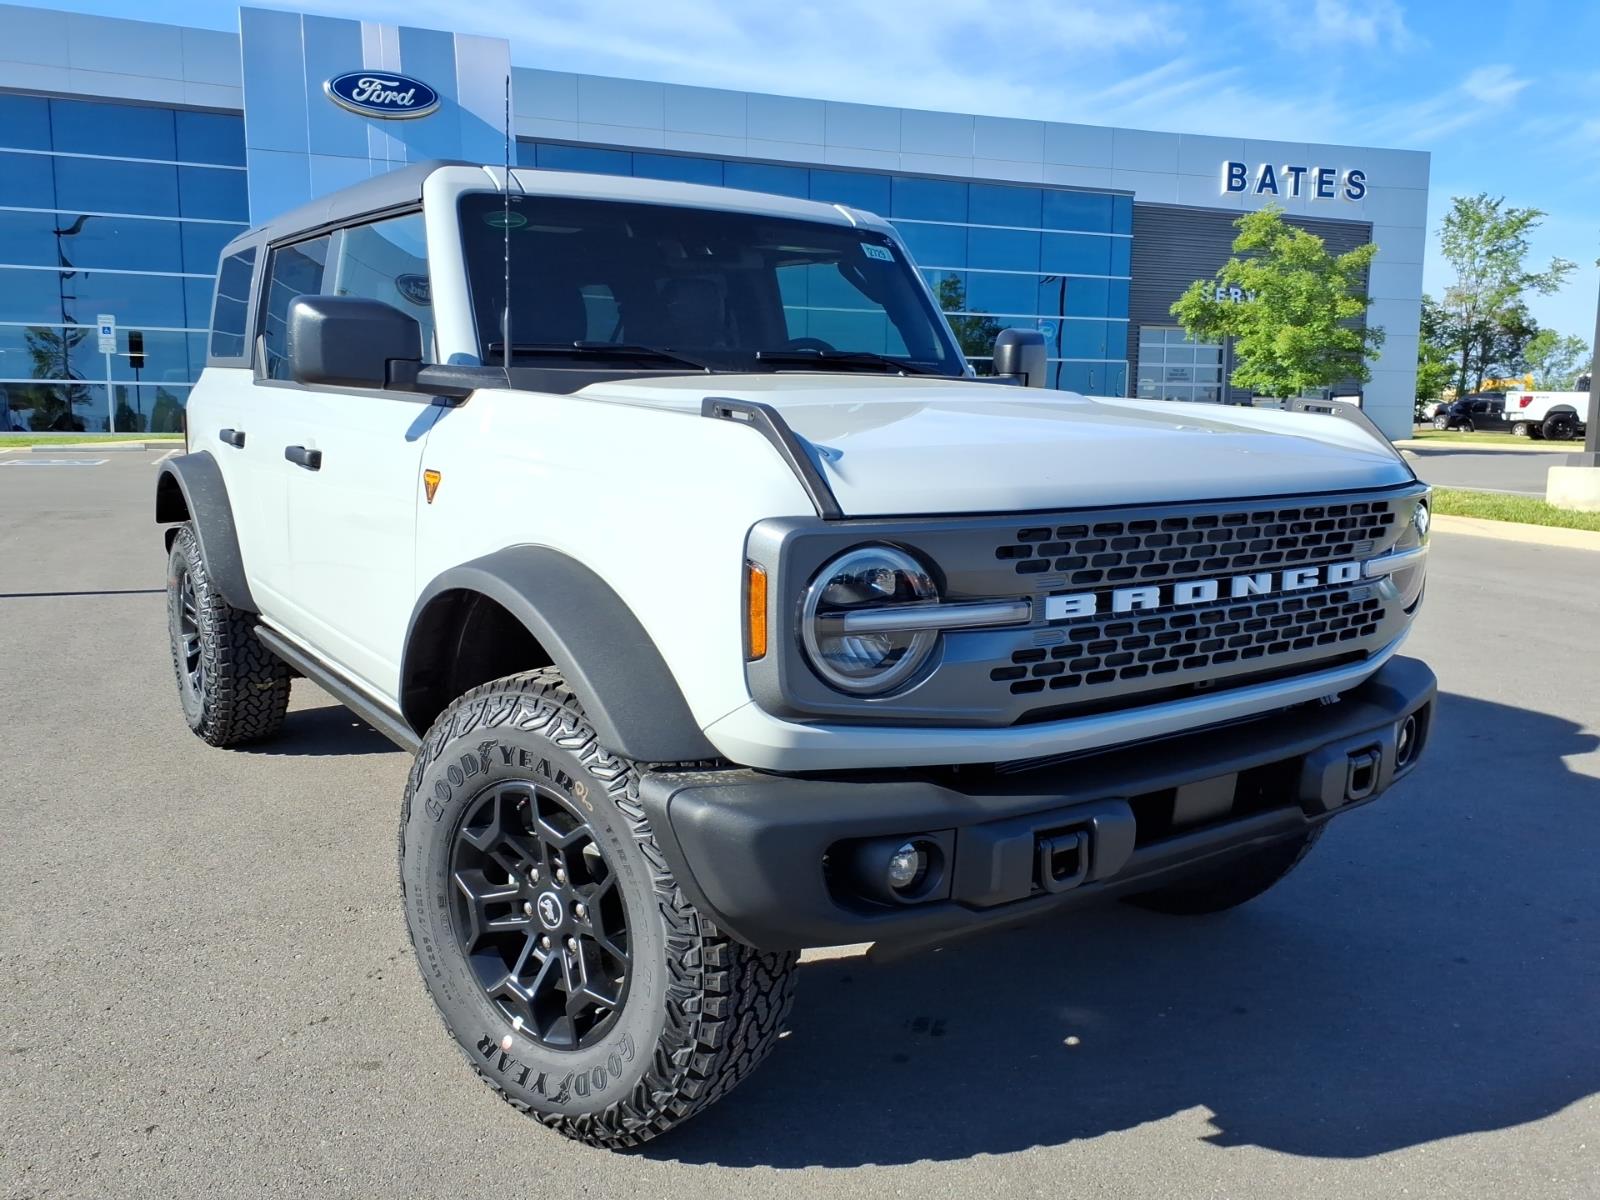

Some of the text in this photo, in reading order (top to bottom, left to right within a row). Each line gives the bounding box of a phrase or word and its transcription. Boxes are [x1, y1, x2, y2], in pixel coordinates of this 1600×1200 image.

[352, 77, 415, 106] Ford
[1221, 160, 1368, 200] BATES
[1045, 561, 1361, 621] BRONCO
[425, 739, 576, 822] GOODYEAR
[477, 1032, 636, 1105] GOODYEAR
